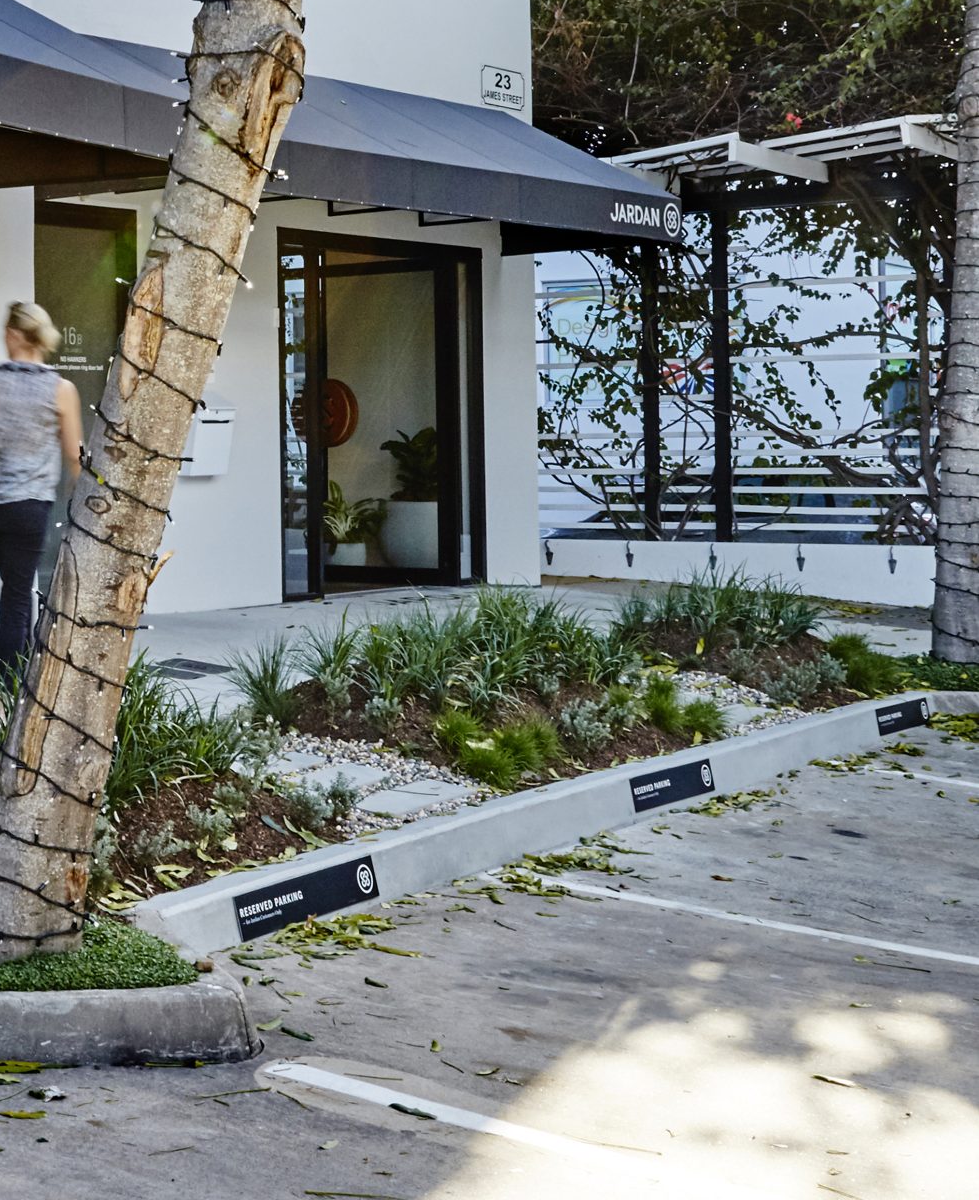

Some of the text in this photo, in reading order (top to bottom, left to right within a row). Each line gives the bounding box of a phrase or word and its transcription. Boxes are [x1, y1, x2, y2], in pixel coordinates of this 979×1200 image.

[495, 72, 512, 90] 23
[484, 90, 522, 105] JAMES STREET
[610, 202, 660, 228] JARDAN
[633, 783, 654, 796] RESERVED
[653, 778, 672, 790] PARKING
[239, 889, 304, 919] RESERVED PARKING
